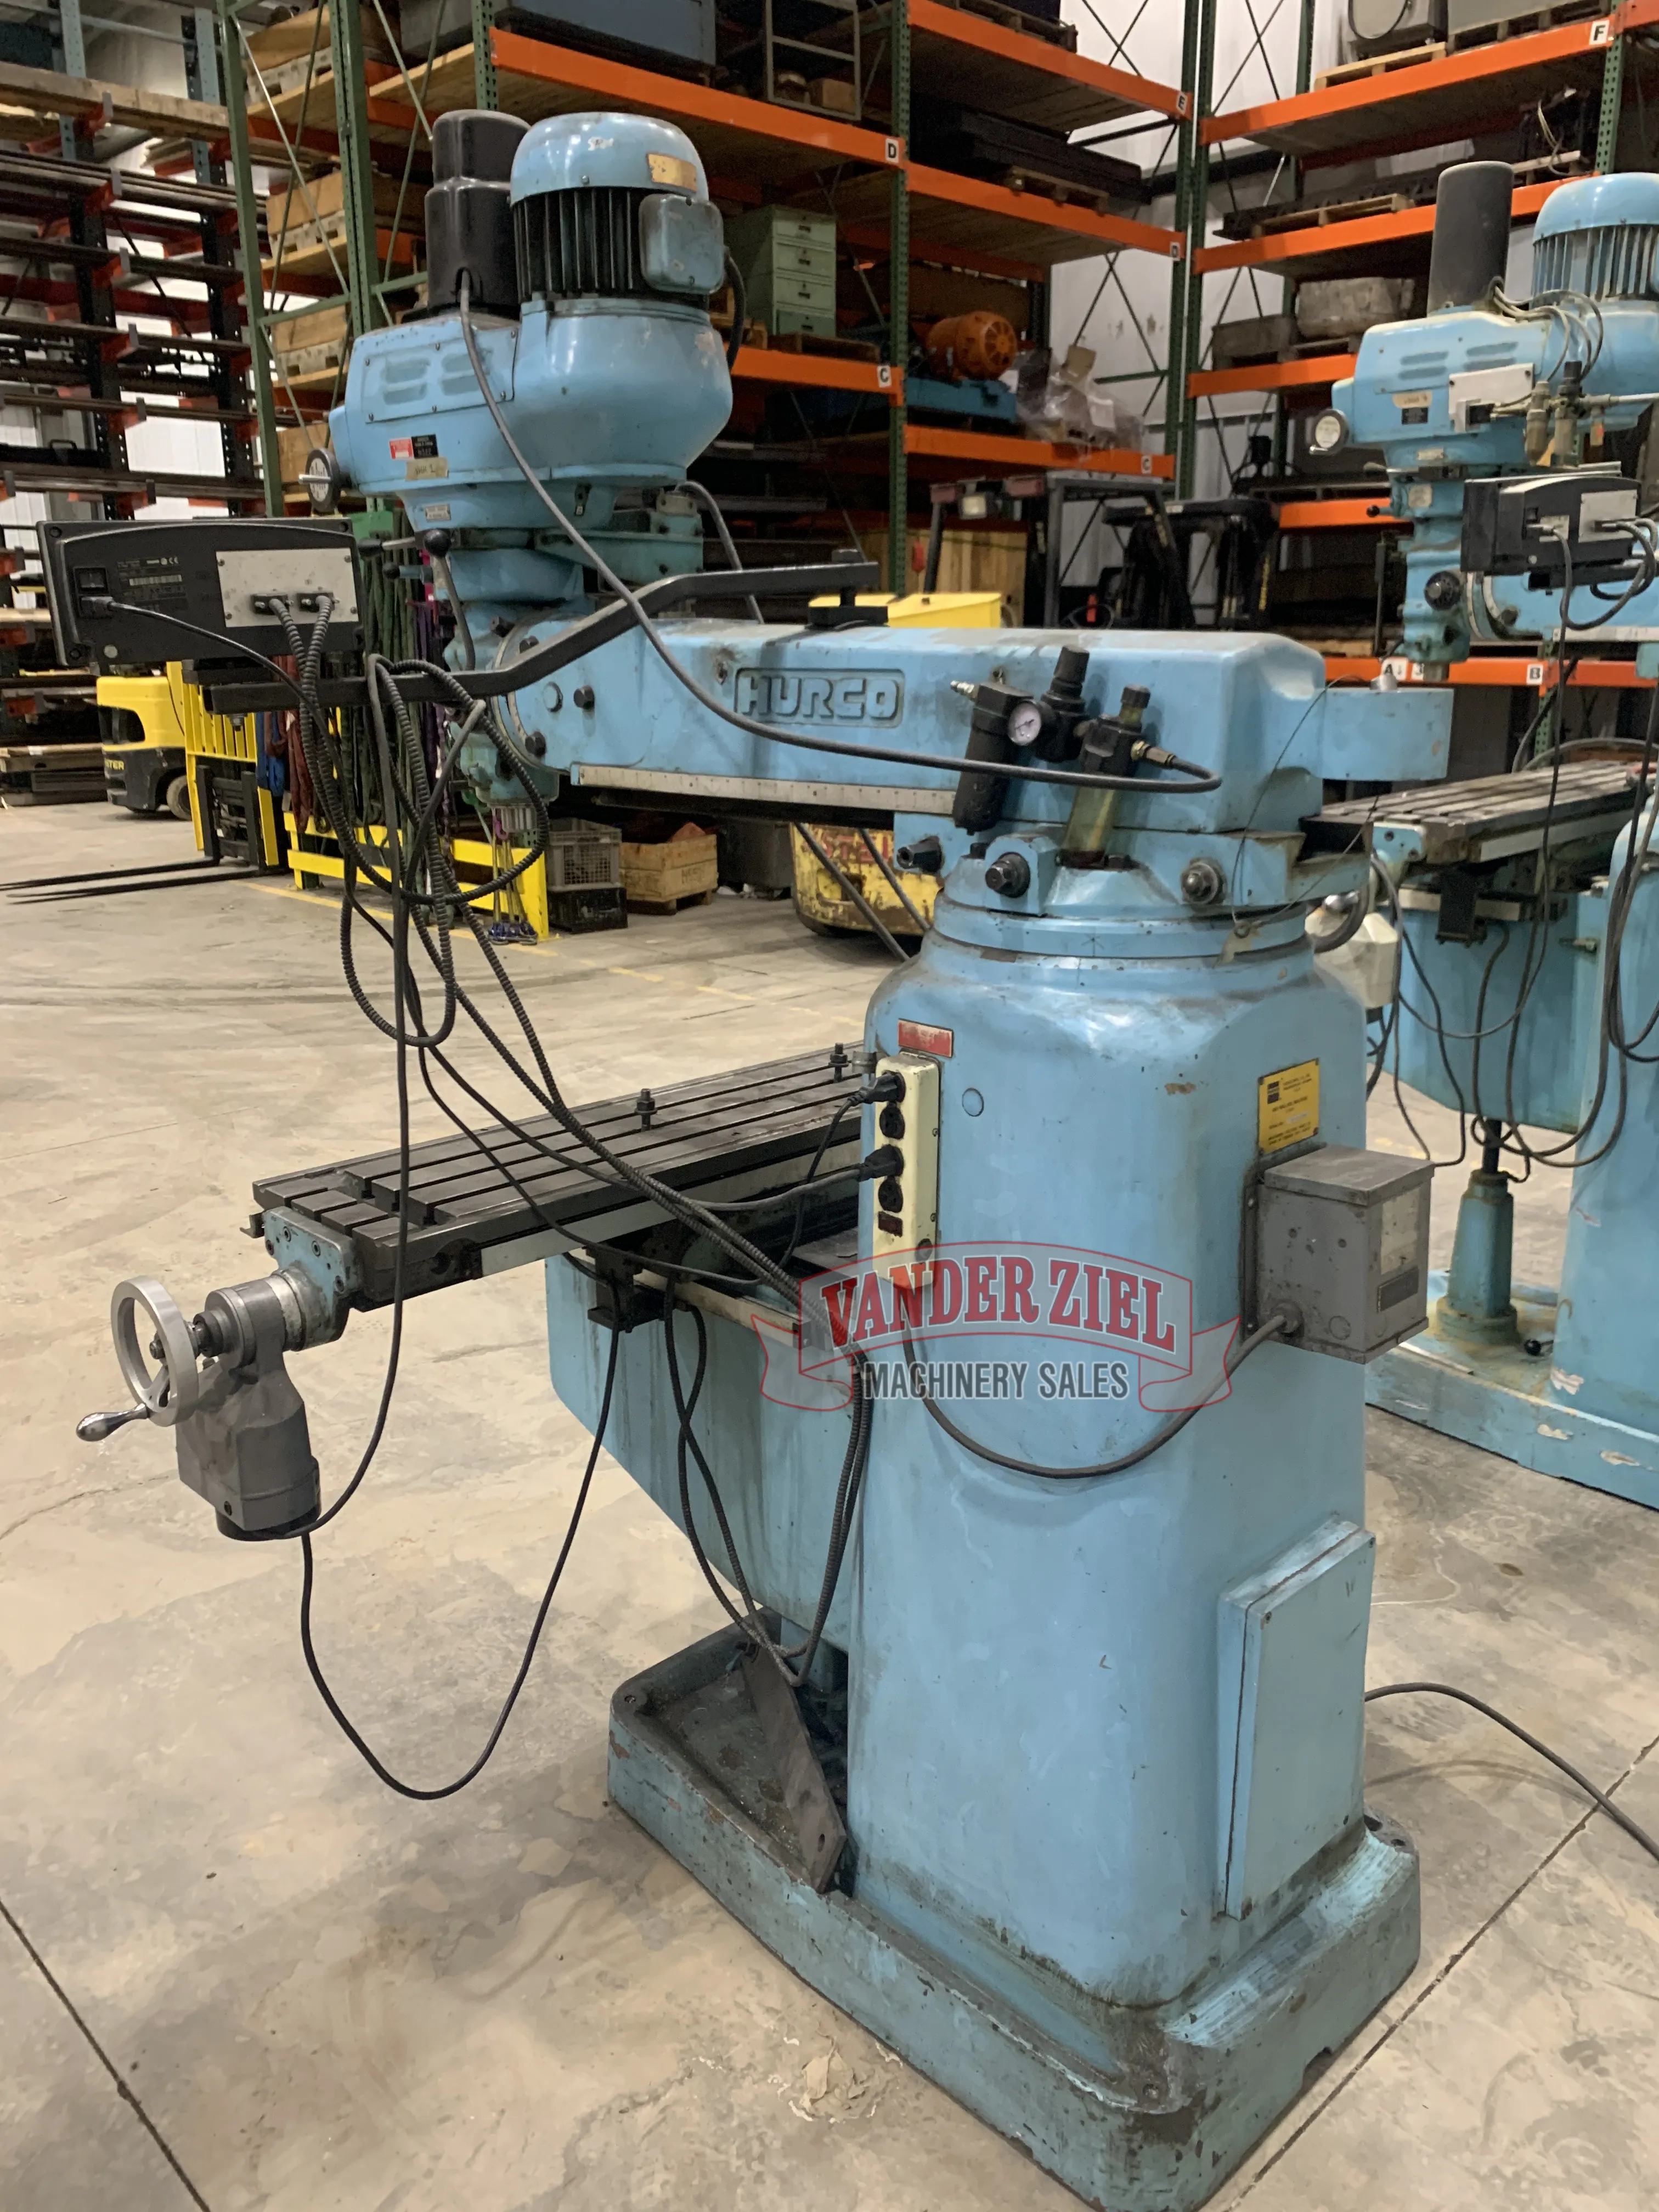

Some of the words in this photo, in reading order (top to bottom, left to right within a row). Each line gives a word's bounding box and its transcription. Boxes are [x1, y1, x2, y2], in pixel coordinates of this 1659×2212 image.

[1593, 25, 1606, 41] F
[1178, 95, 1185, 110] E
[888, 143, 896, 159] D
[881, 368, 889, 382] C
[1143, 458, 1150, 471] C
[1530, 667, 1541, 679] B
[736, 675, 900, 720] HURCO
